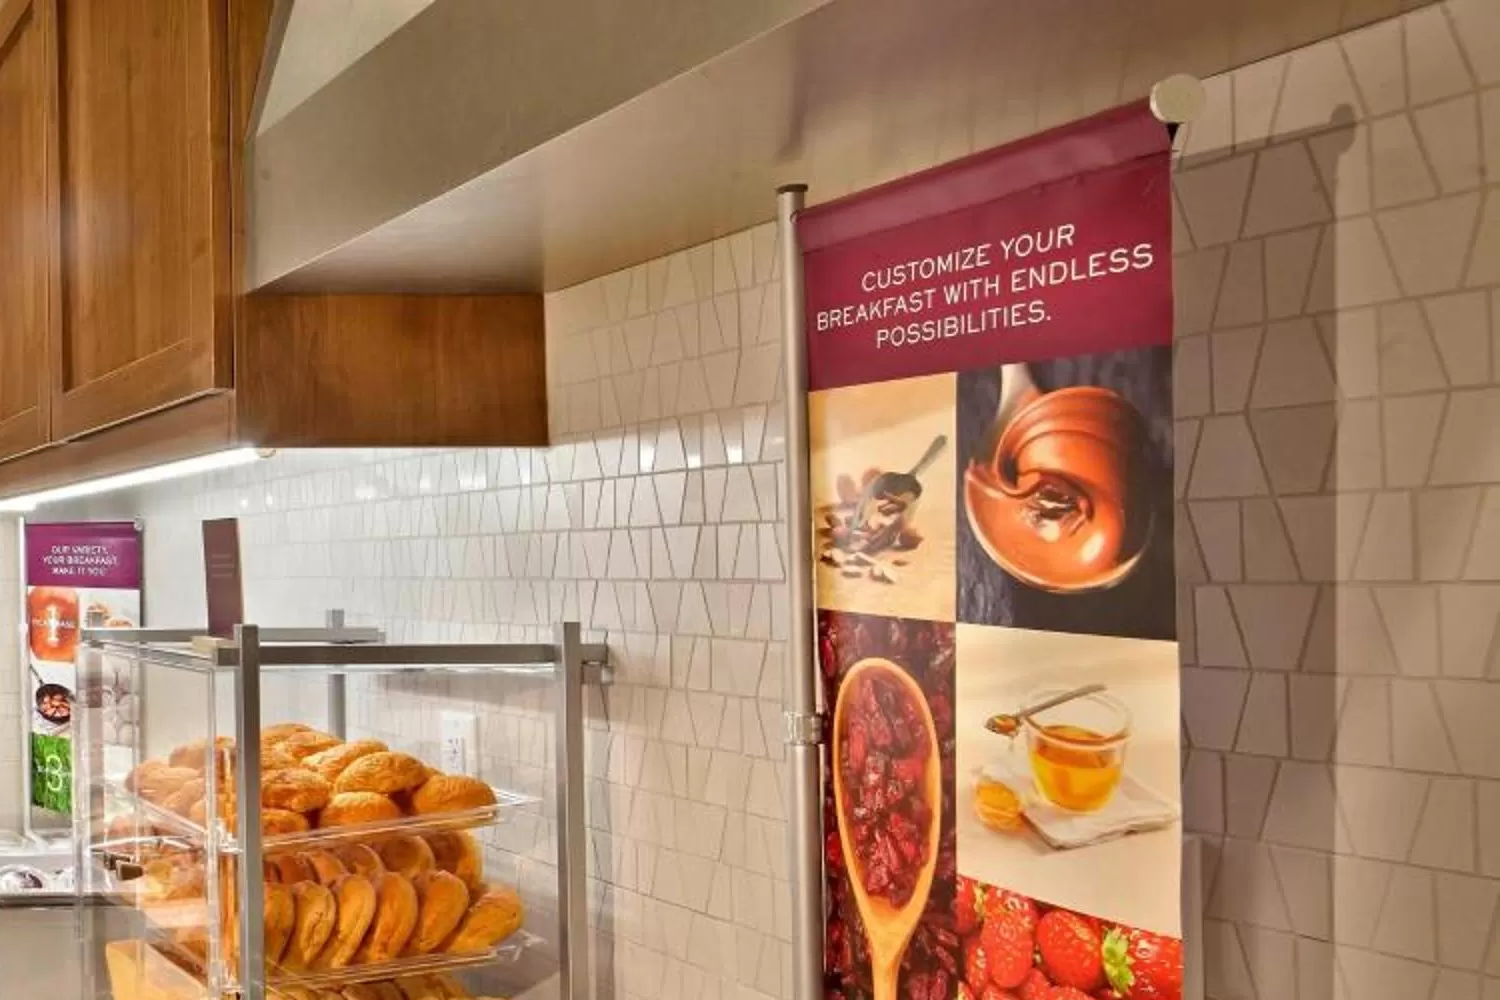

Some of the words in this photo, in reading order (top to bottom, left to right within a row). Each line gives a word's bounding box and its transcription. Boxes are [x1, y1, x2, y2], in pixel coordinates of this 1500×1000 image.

[861, 243, 991, 292] CUSTOMIZE
[1000, 223, 1075, 261] YOUR
[816, 288, 936, 332] BREAKFAST
[944, 274, 1000, 306] WITH
[1011, 243, 1154, 292] ENDLESS
[876, 300, 1052, 349] POSSIBILITIES.
[43, 555, 65, 565] YOUR
